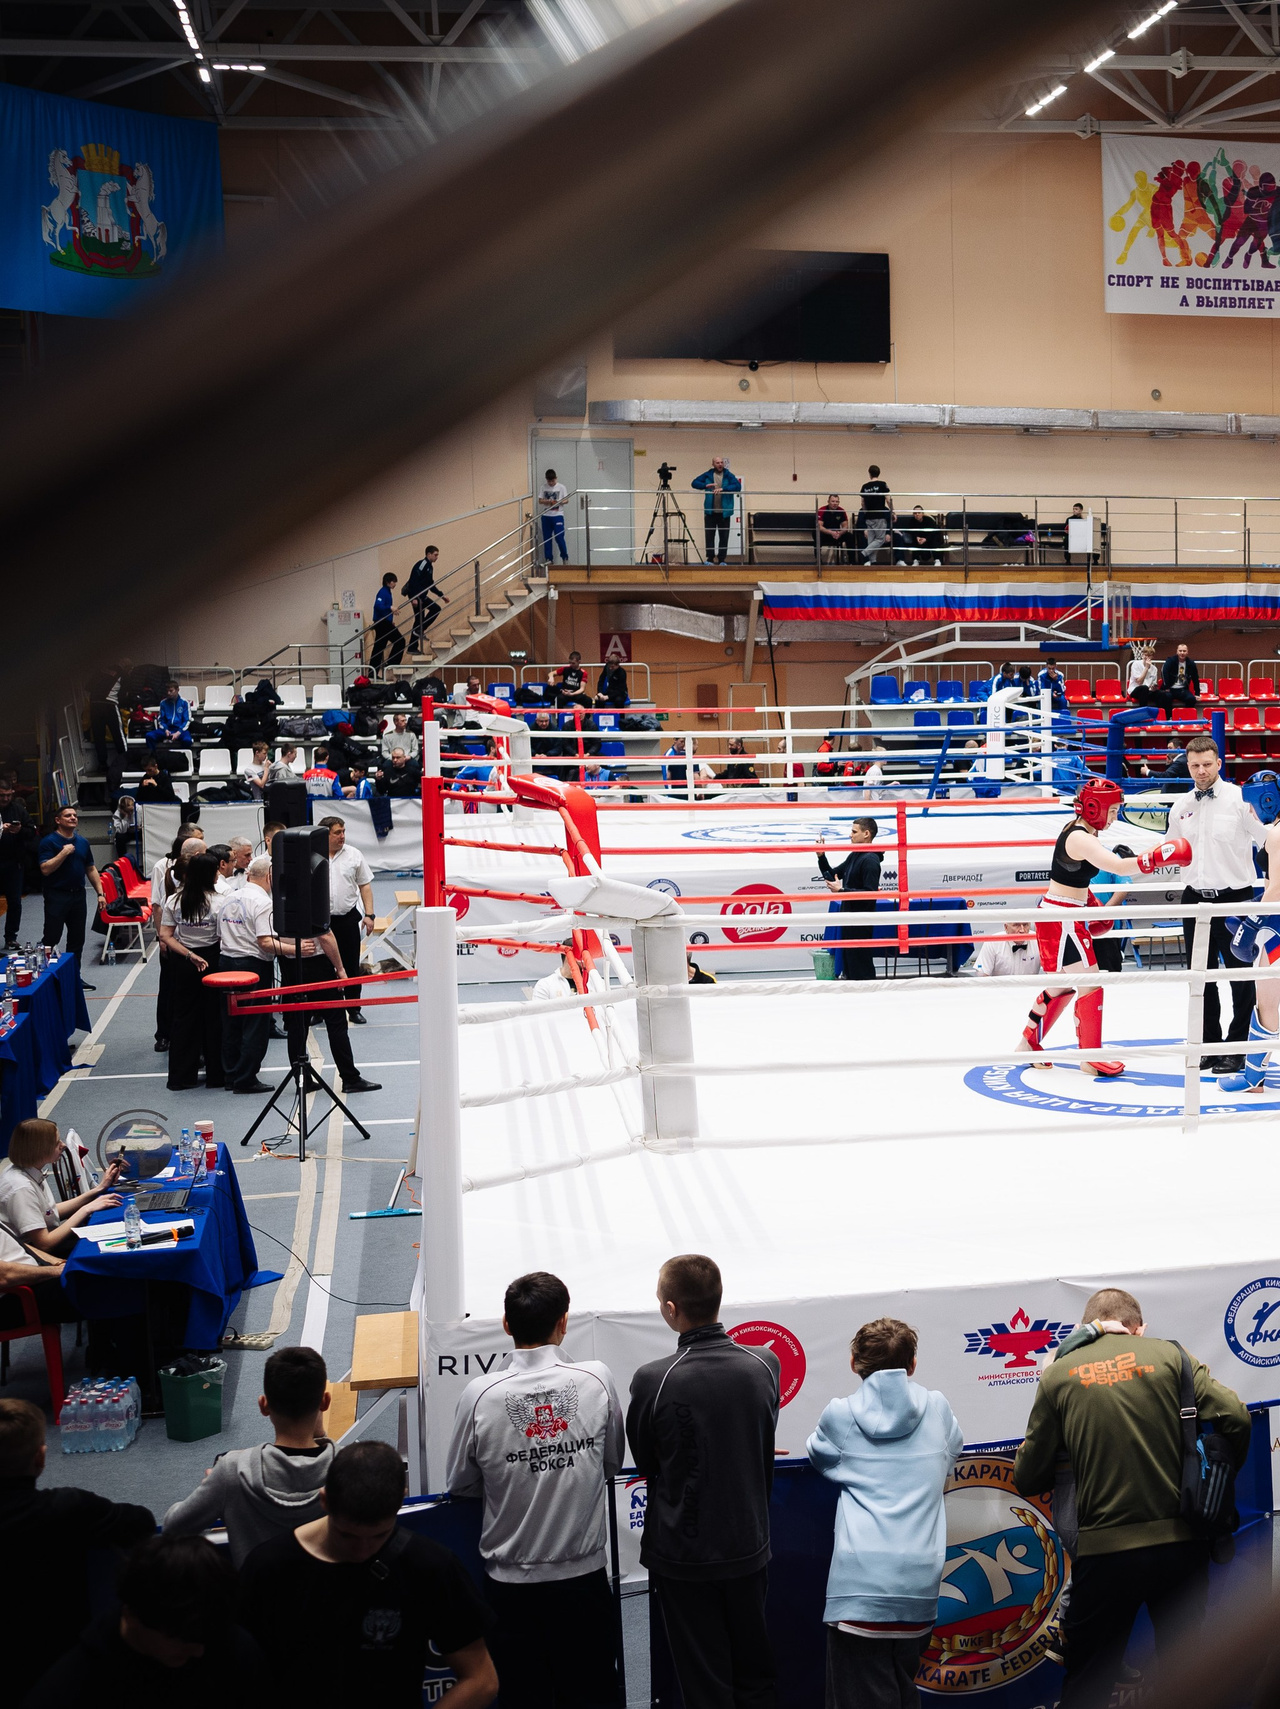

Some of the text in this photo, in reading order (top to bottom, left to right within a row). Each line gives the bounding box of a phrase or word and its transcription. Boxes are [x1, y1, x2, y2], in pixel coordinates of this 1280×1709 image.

[1107, 274, 1153, 288] СПОРТ
[1160, 276, 1180, 289] НЕ
[1179, 295, 1190, 307] А
[1196, 296, 1274, 310] ВЫЯВЛЯЕТ
[605, 634, 627, 657] А
[801, 933, 825, 942] БОЧК
[1227, 1281, 1262, 1325] ФЕДЕРАЦИЯ
[739, 1325, 782, 1337] КИКБОКСИНГА
[781, 1334, 800, 1357] РОССИИ
[438, 1353, 508, 1376] RIV
[1238, 1350, 1280, 1366] АЛТАЙСКИЙ
[978, 1370, 1033, 1381] МИНИСТЕРСТВО
[988, 1377, 1034, 1387] АЛТАЙСКОГО
[785, 1377, 799, 1398] RUSSIA
[505, 1437, 595, 1464] ФЕДЕРАЦИЯ
[530, 1455, 575, 1473] БОКСА
[917, 1608, 1061, 1687] KARATE FEDERAT
[959, 1635, 984, 1648] WKF
